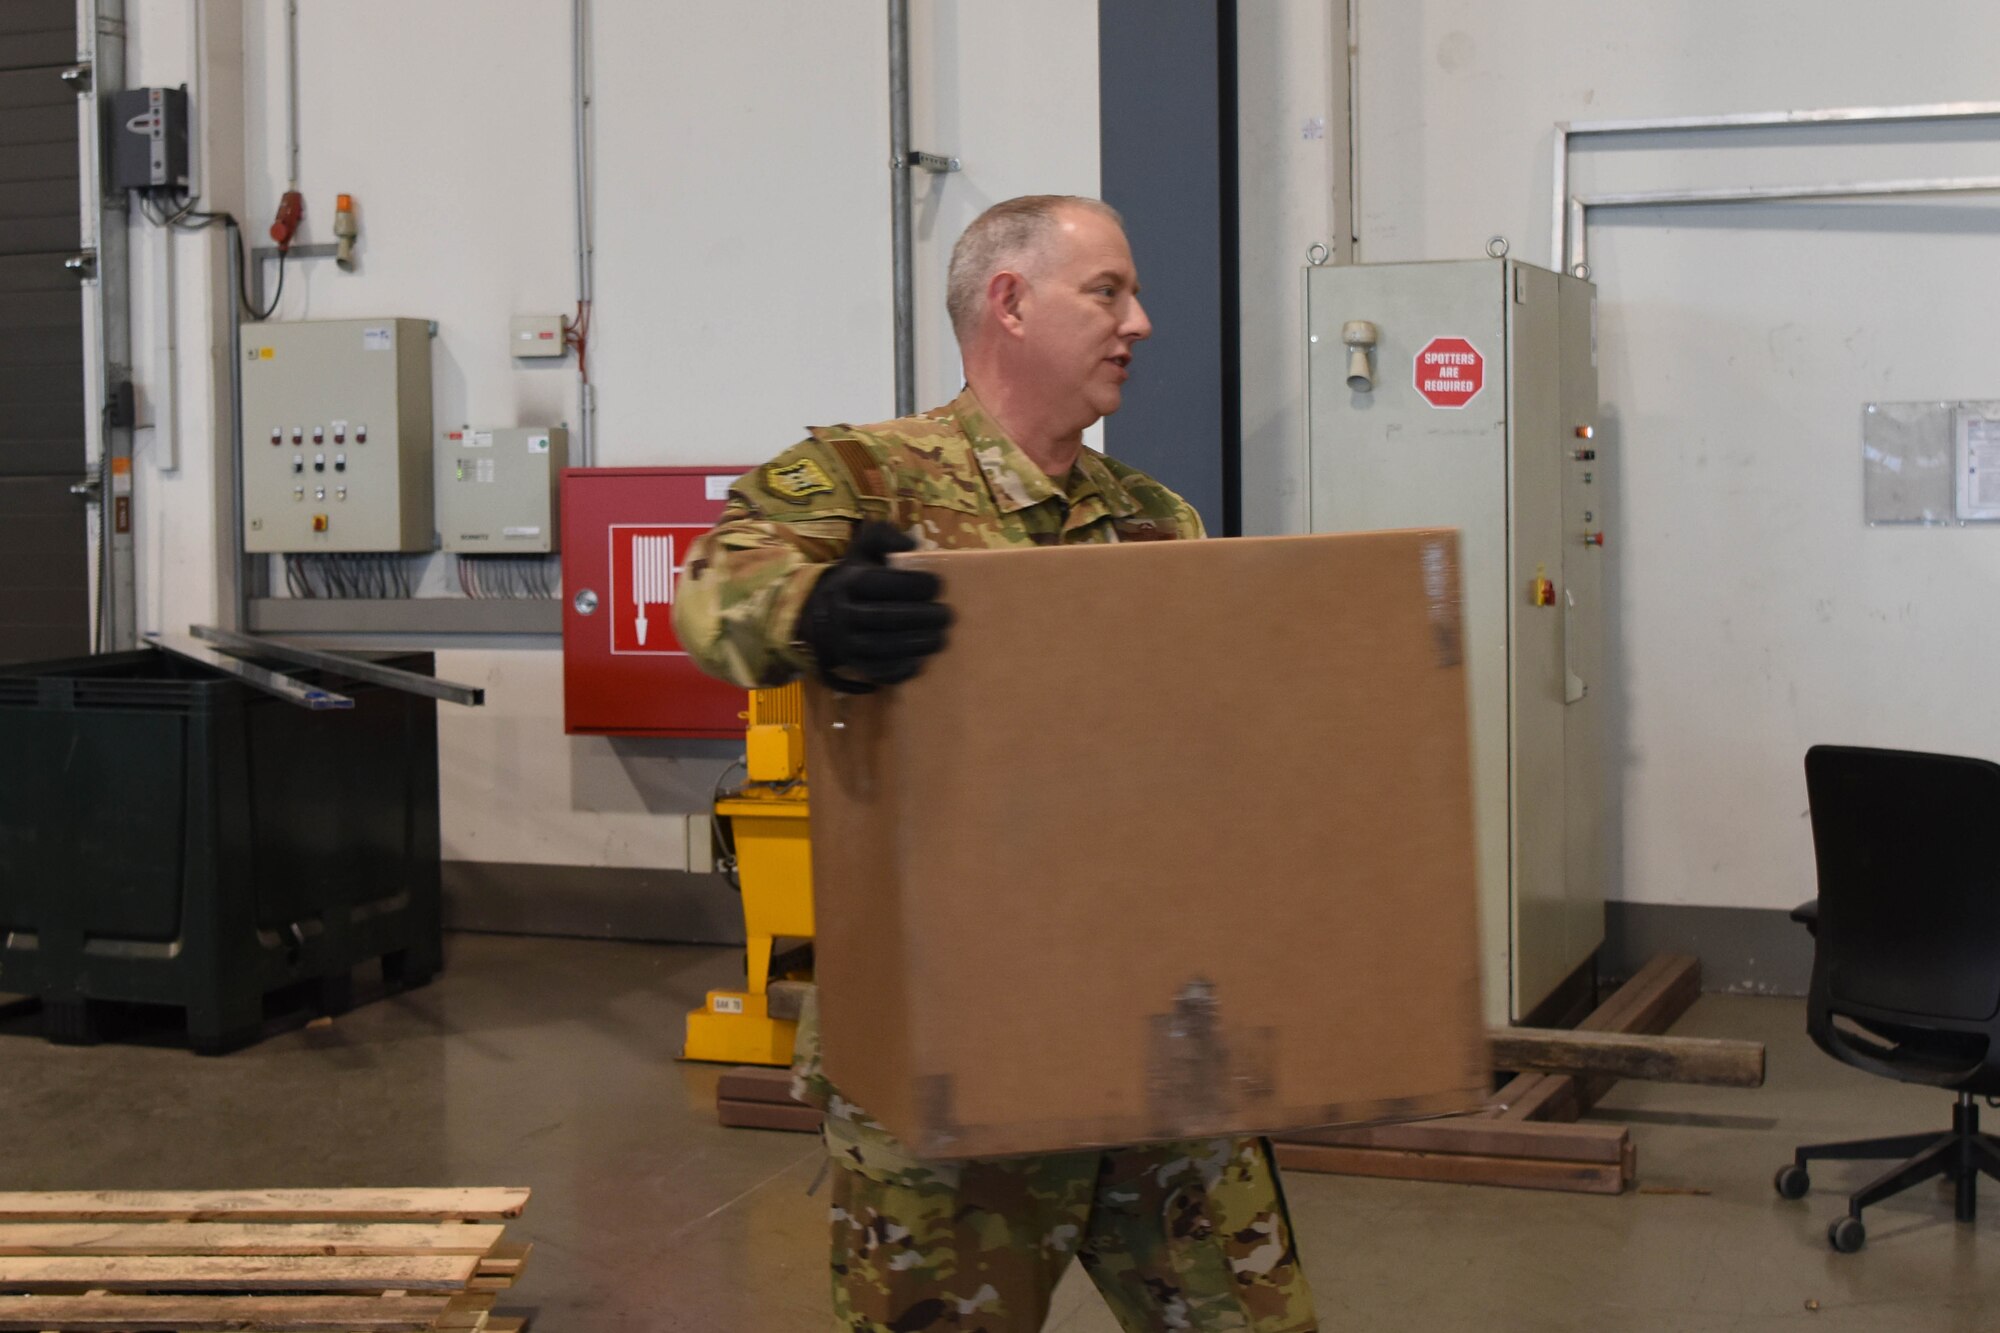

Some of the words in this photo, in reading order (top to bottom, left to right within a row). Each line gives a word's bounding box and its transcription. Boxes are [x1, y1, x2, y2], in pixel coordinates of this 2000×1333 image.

[1424, 352, 1475, 365] SPOTTERS
[1439, 366, 1459, 378] ARE
[1424, 380, 1474, 392] REQUIRED
